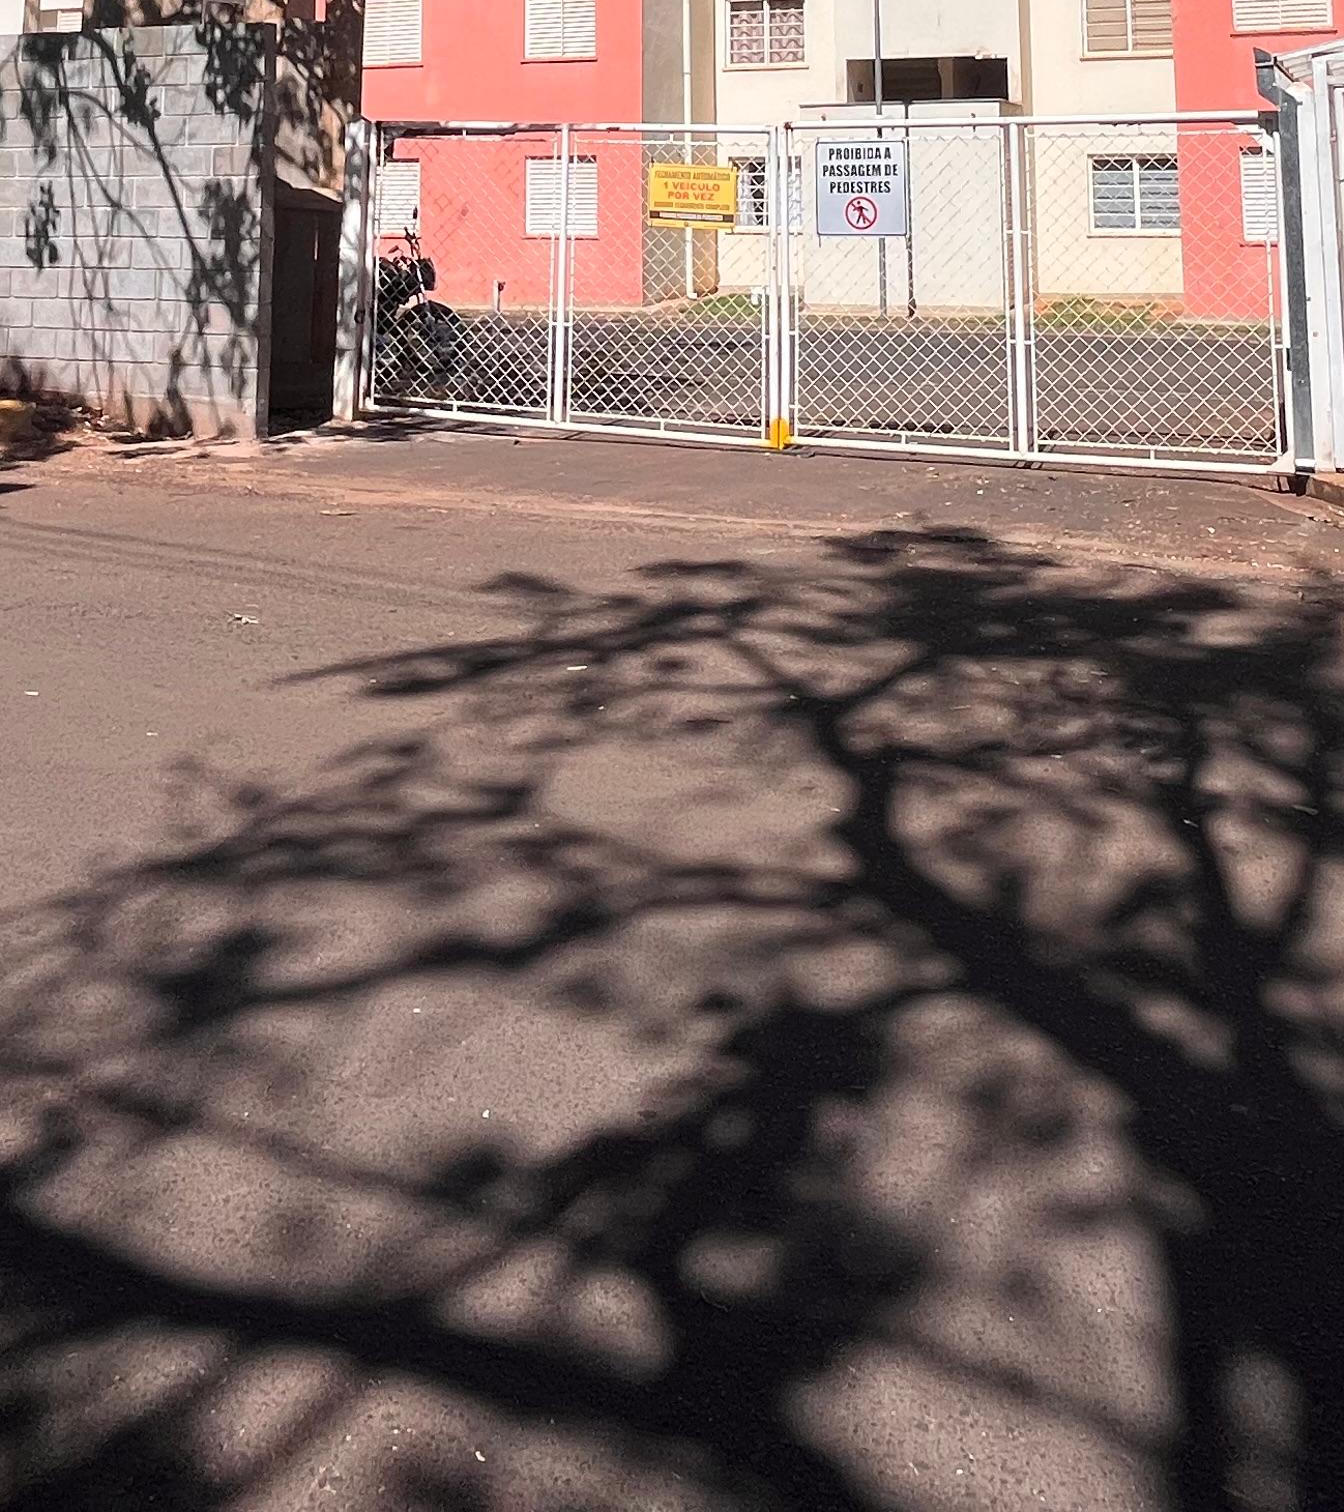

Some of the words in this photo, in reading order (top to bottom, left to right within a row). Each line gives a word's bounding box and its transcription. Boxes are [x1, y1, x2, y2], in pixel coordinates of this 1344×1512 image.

[828, 147, 882, 161] PROIBIDA
[883, 147, 892, 160] A
[822, 164, 882, 177] PASSAGEM
[884, 164, 899, 176] DE
[663, 181, 669, 189] 1
[829, 181, 891, 194] PEDESTRES
[667, 191, 690, 200] POR
[692, 192, 715, 201] VEZ
